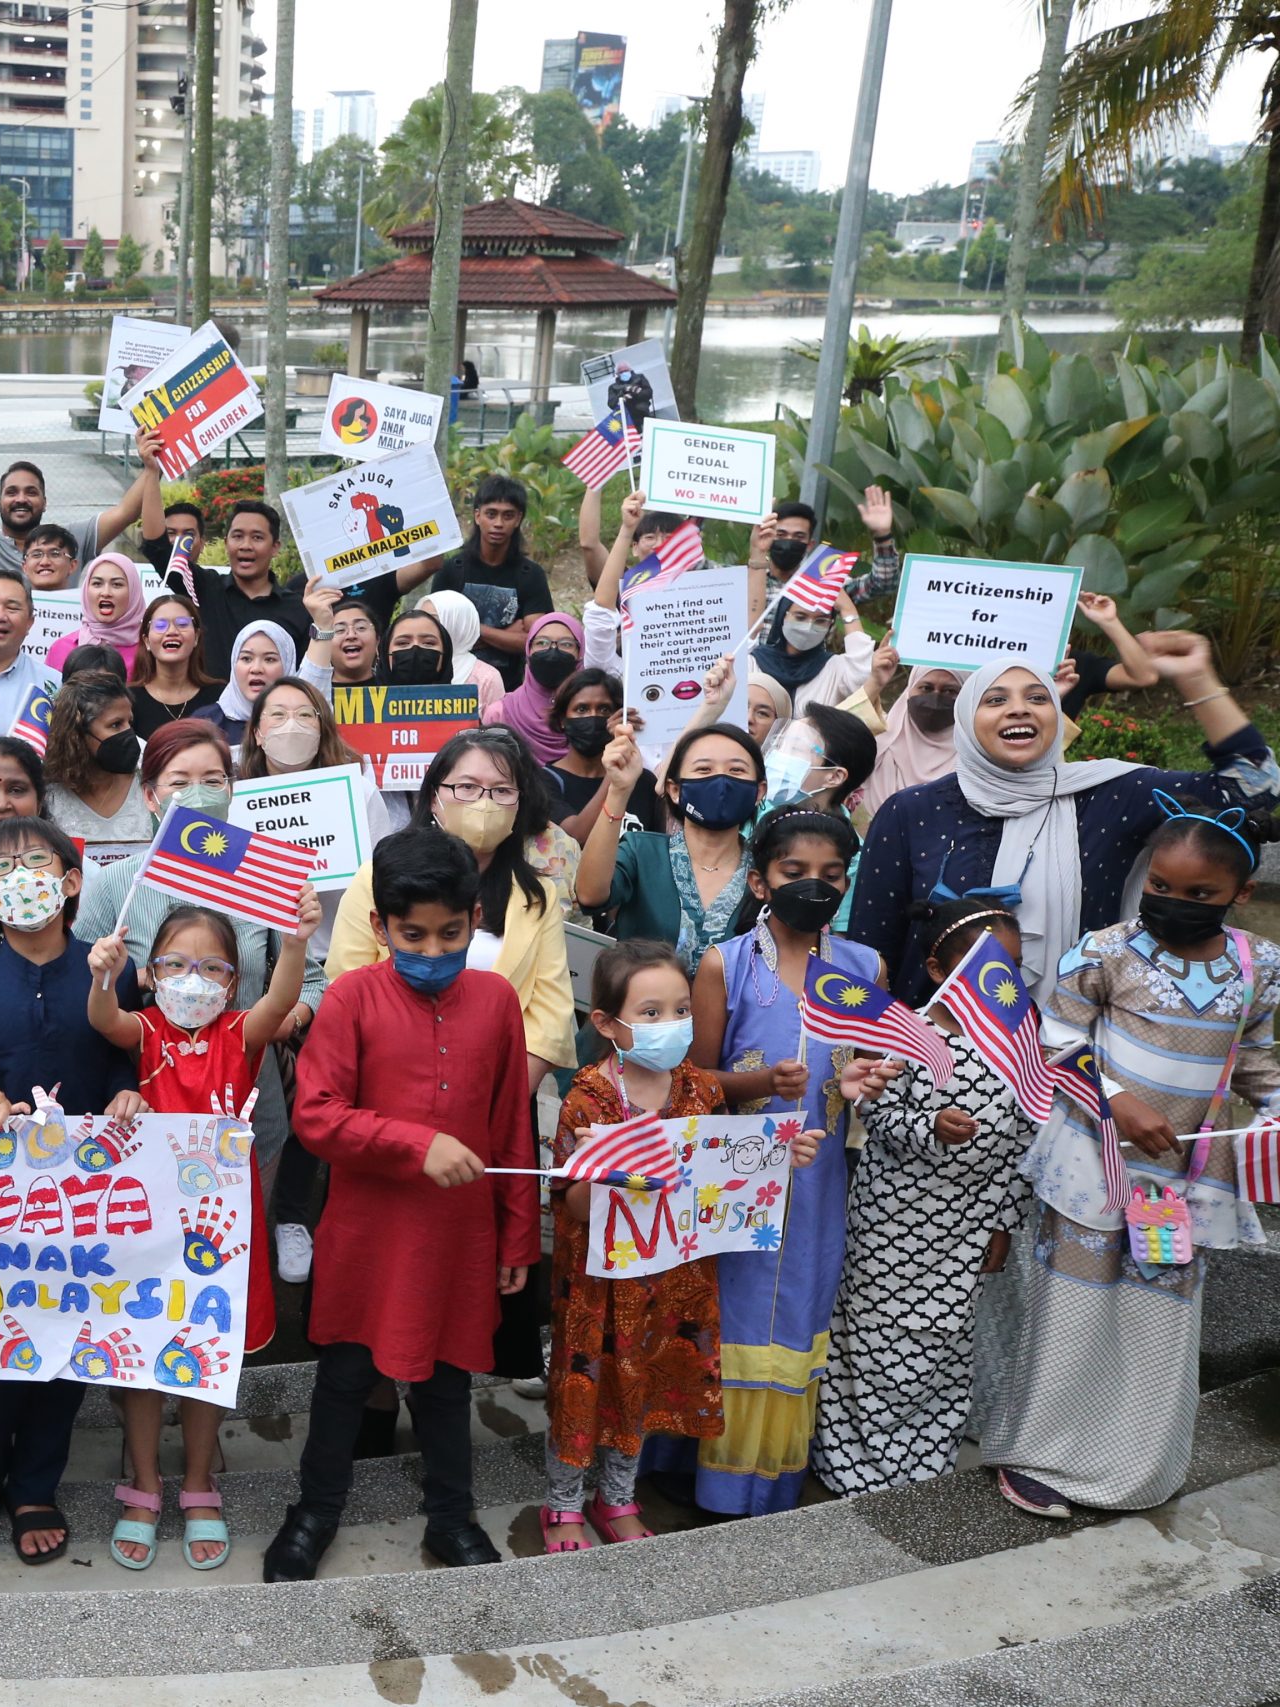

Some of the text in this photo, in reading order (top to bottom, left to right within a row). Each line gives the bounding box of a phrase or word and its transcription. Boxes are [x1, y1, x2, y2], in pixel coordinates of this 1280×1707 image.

[132, 350, 231, 433] MY CITIZENSHIP
[185, 400, 207, 422] FOR
[384, 406, 433, 426] SAYA JUGA
[199, 404, 249, 446] CHILDREN
[381, 421, 405, 435] ANAK
[684, 438, 735, 452] GENDER
[688, 456, 730, 469] EQUAL
[667, 470, 747, 488] CITIZENSHIP
[329, 473, 394, 509] SAYA JUGA
[675, 489, 695, 499] WO
[710, 493, 738, 505] MAN
[332, 525, 433, 570] ANAK MALAYSIA
[927, 580, 1053, 605] MYCitizenship
[646, 602, 674, 612] when
[683, 599, 703, 608] find
[706, 597, 723, 605] out
[664, 608, 705, 619] that the
[972, 609, 998, 623] for
[643, 615, 727, 632] government still
[43, 628, 63, 638] For
[641, 625, 730, 640] hasn't withdrawn
[640, 633, 731, 649] their court appeal
[927, 631, 1028, 652] MYChildren
[660, 645, 711, 657] and given
[649, 652, 723, 667] mothers equal
[640, 666, 695, 677] citizenship
[334, 686, 477, 724] MY CITIZENSHIP
[391, 730, 418, 746] FOR
[247, 791, 312, 811] GENDER
[256, 815, 309, 833] EQUAL
[702, 1134, 732, 1150] anak
